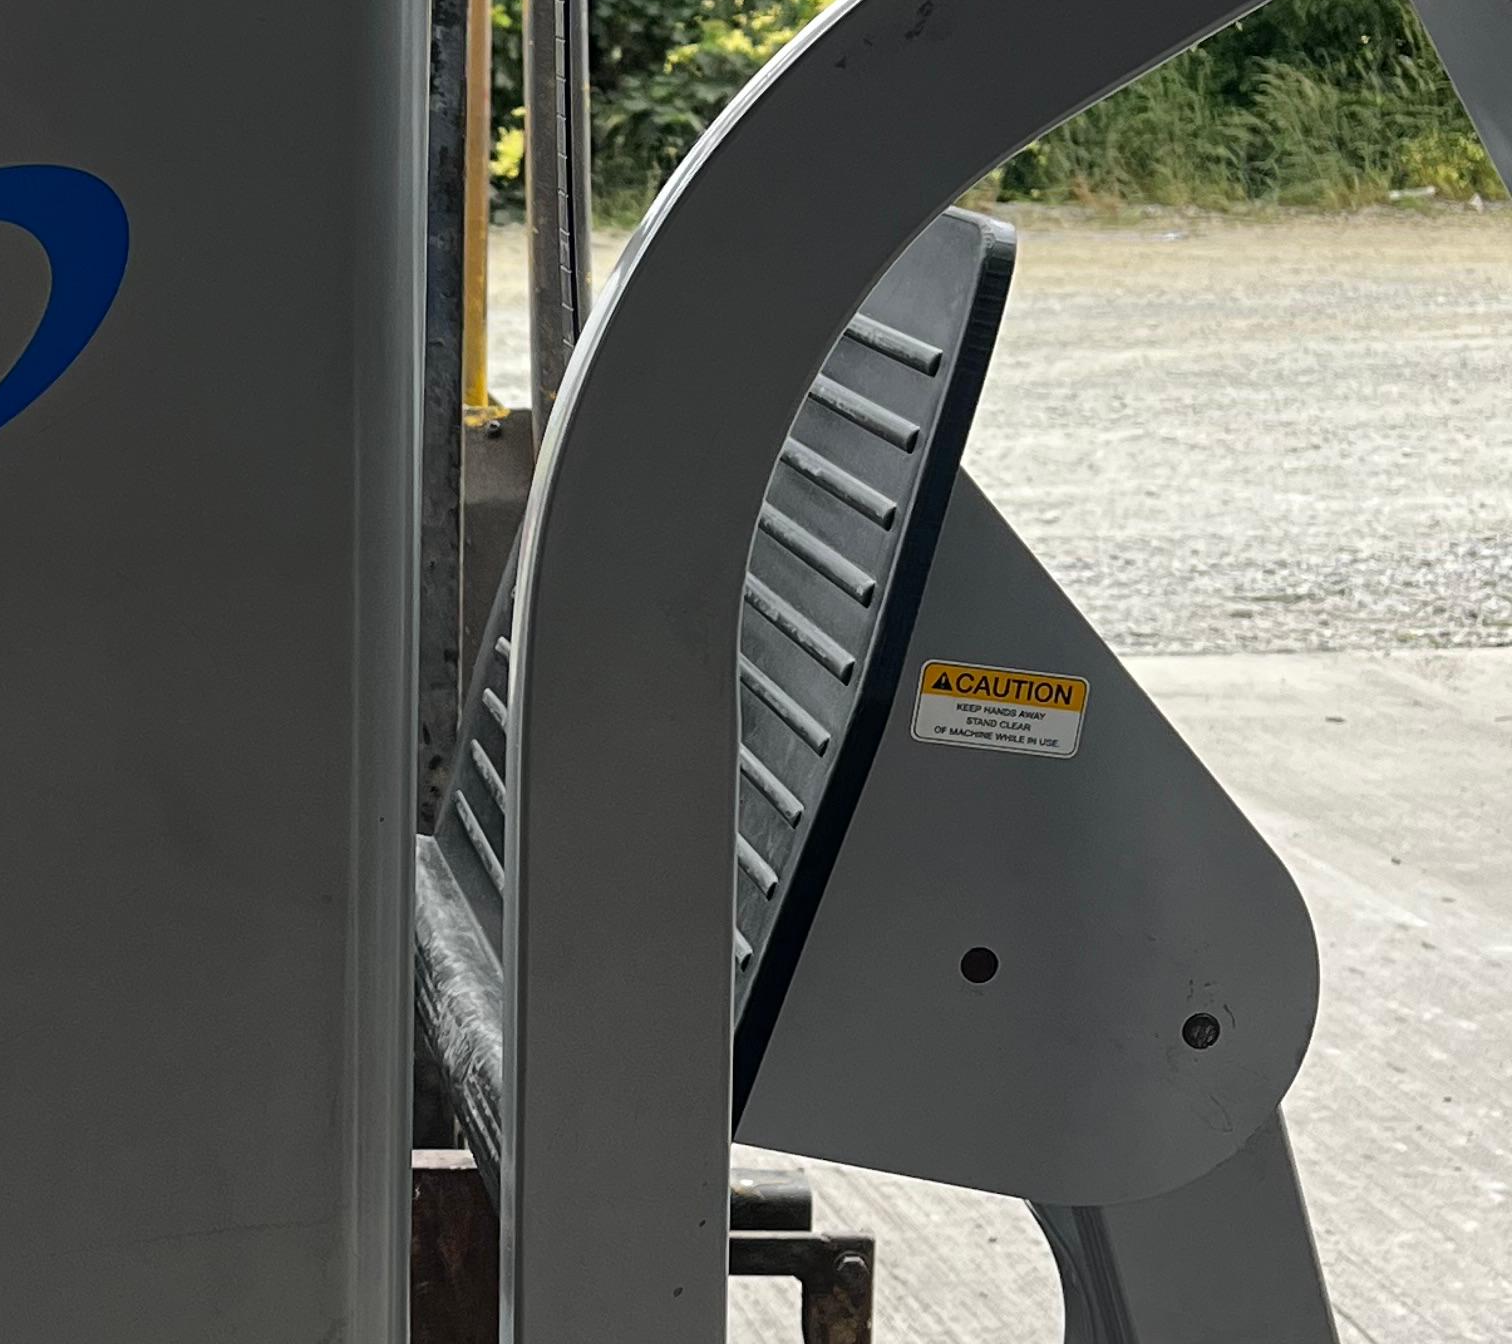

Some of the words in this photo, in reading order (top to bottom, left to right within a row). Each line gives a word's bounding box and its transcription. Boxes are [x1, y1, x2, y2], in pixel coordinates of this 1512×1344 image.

[956, 673, 1073, 705] CAUTION
[956, 703, 982, 713] KEEP
[983, 706, 1017, 717] HANDS
[1018, 710, 1046, 720] AWAY
[966, 716, 997, 728] STAND
[999, 720, 1031, 731] CLEAR
[934, 725, 947, 734] OF
[949, 727, 994, 740] MACHINE
[995, 733, 1025, 744] WHILE
[1026, 736, 1037, 745] IN
